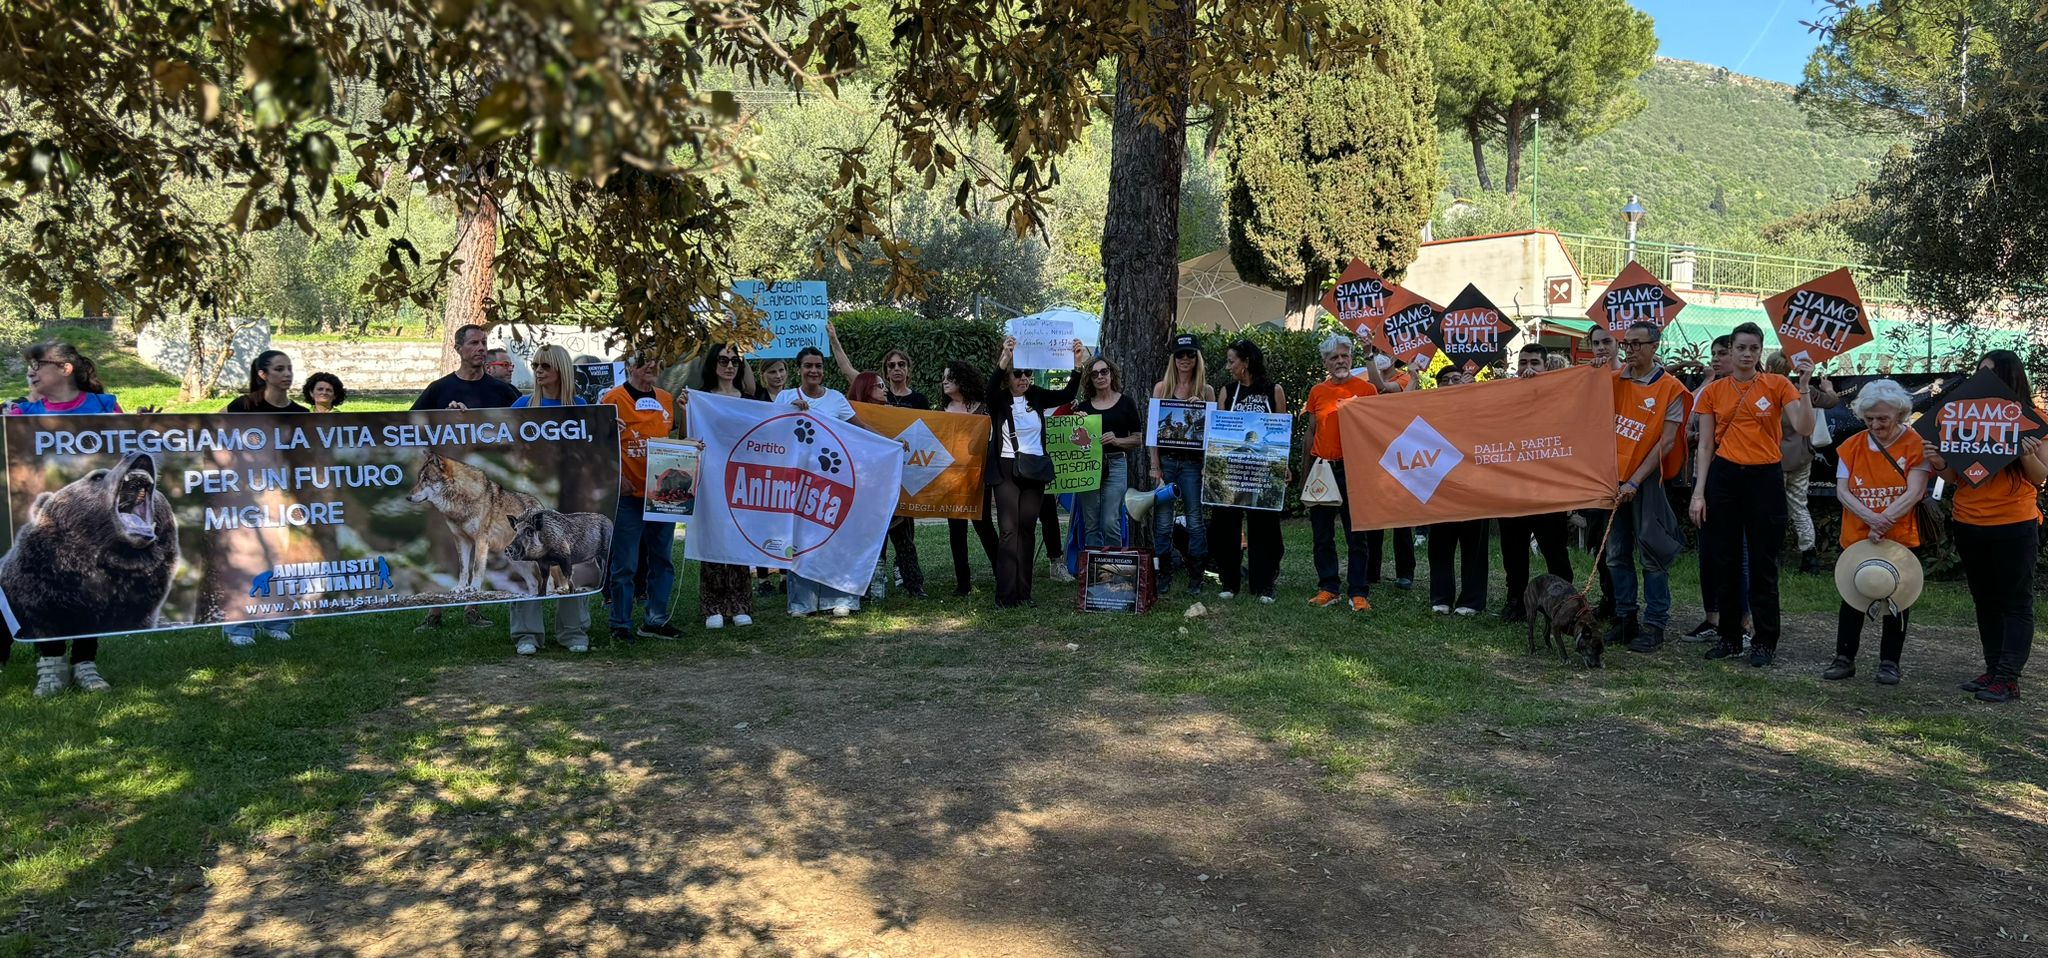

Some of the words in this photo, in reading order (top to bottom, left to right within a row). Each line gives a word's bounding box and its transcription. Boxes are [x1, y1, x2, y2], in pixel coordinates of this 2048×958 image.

[1337, 280, 1382, 296] SIAMO
[1607, 287, 1663, 304] SIAMO
[811, 296, 827, 306] DEL
[1337, 293, 1384, 311] TUTTI
[1793, 290, 1858, 322] SIAMO
[1340, 308, 1384, 320] BERSAGLI
[1385, 304, 1432, 330] SIAMO
[1444, 311, 1498, 326] SIAMO
[1607, 301, 1664, 321] TUTTI
[775, 325, 786, 335] LO
[789, 324, 817, 333] SANNO
[1609, 318, 1664, 331] BERLI
[1786, 305, 1852, 342] TUTTI
[1444, 327, 1497, 343] TUTTI
[1779, 324, 1843, 353] BERSAGLI
[1393, 336, 1432, 355] BERSAG
[1445, 343, 1498, 353] BERSAGLI
[1943, 402, 2021, 420] SIAMO
[35, 428, 267, 456] PROTEGGIAMO
[274, 427, 311, 450] LA
[316, 424, 376, 449] VITA
[382, 422, 513, 447] SELVATICA
[519, 419, 593, 443] OGGI,
[1941, 421, 2019, 442] TUTTI
[747, 441, 785, 455] Partito
[1475, 442, 1516, 455] DALLA
[1521, 436, 1562, 448] PARTE
[1940, 441, 2018, 455] BERSAGLI
[904, 449, 936, 467] AV
[1396, 448, 1441, 471] LAV
[1475, 454, 1512, 465] DEGLI
[1517, 447, 1573, 462] ANIMALI
[184, 469, 240, 494] PER
[248, 467, 288, 491] UN
[295, 464, 403, 489] FUTURO
[732, 467, 841, 525] Animalista
[204, 502, 345, 531] MIGLIORE
[909, 503, 936, 512] DEGLI
[939, 505, 978, 513] ANIMALI
[273, 559, 374, 578] ANIMALISTI
[276, 574, 372, 596] ITALIANI
[246, 594, 399, 614] WWW.ANIMALISTI.IT
